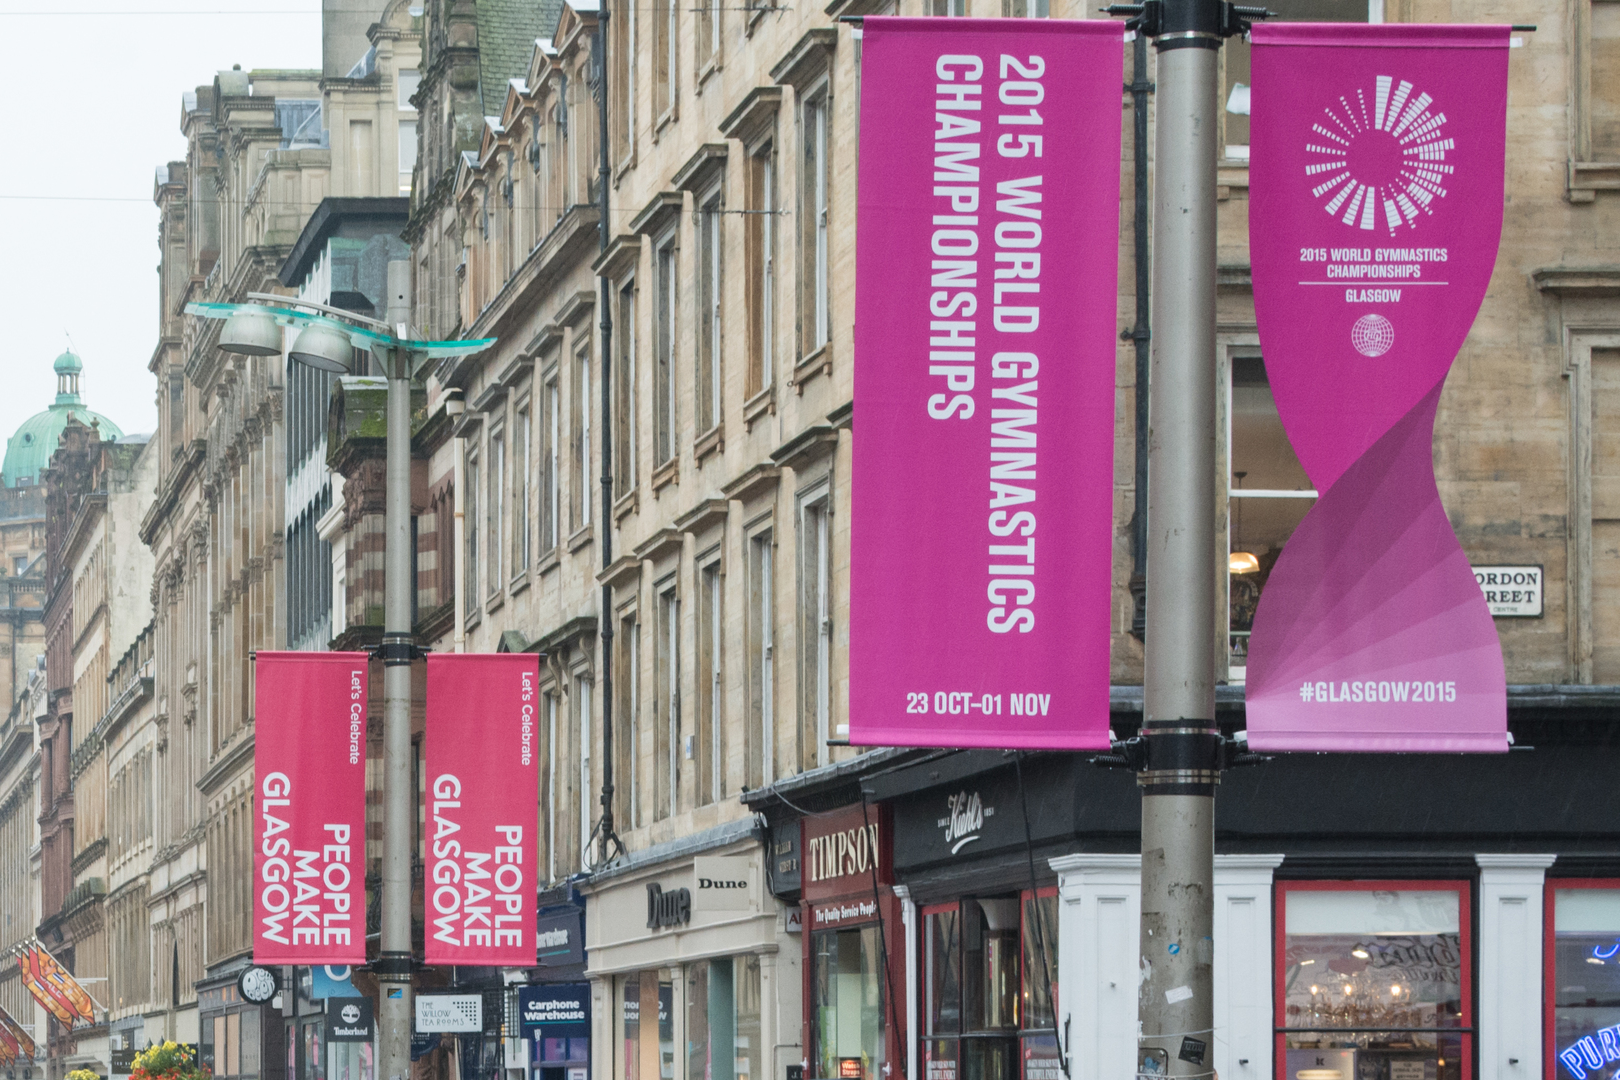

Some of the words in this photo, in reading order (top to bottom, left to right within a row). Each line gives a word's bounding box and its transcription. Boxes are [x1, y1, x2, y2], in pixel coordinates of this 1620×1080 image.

[997, 53, 1045, 158] 2015
[927, 54, 984, 420] CHAMPIONSHIPS
[993, 175, 1043, 333] WORLD
[1300, 248, 1328, 262] 2015
[1331, 248, 1371, 262] WORLD
[1375, 248, 1448, 262] GYMNASTICS
[1327, 264, 1421, 278] CHAMPIONSHIPS
[1345, 289, 1401, 303] GLASGOW
[986, 351, 1040, 634] GYMNASTICS
[1475, 572, 1538, 586] ORDON
[1485, 590, 1535, 603] REET
[351, 670, 362, 700] Let's
[522, 671, 533, 701] Let's
[1299, 681, 1456, 702] #GLASGOW2015
[906, 692, 928, 715] 23
[1010, 693, 1051, 716] NOV
[350, 702, 362, 765] Celebrate
[521, 703, 533, 766] Celebrate
[262, 771, 291, 945] GLASGOW
[433, 773, 461, 947] GLASGOW
[809, 823, 879, 882] TIMPSON
[293, 850, 320, 945] MAKE
[323, 823, 350, 945] PEOPLE
[495, 825, 522, 947] PEOPLE
[698, 878, 747, 889] Dune
[464, 852, 491, 947] MAKE
[646, 882, 691, 929] Dune
[816, 909, 824, 922] The
[825, 907, 840, 924] Quality
[841, 904, 859, 919] Service
[422, 1010, 451, 1018] WILLOW
[524, 1010, 585, 1021] Warehouse
[528, 1000, 580, 1011] Carphone
[334, 1027, 368, 1036] Timberland
[437, 1018, 465, 1026] ROOMS
[1560, 1023, 1620, 1080] PUR
